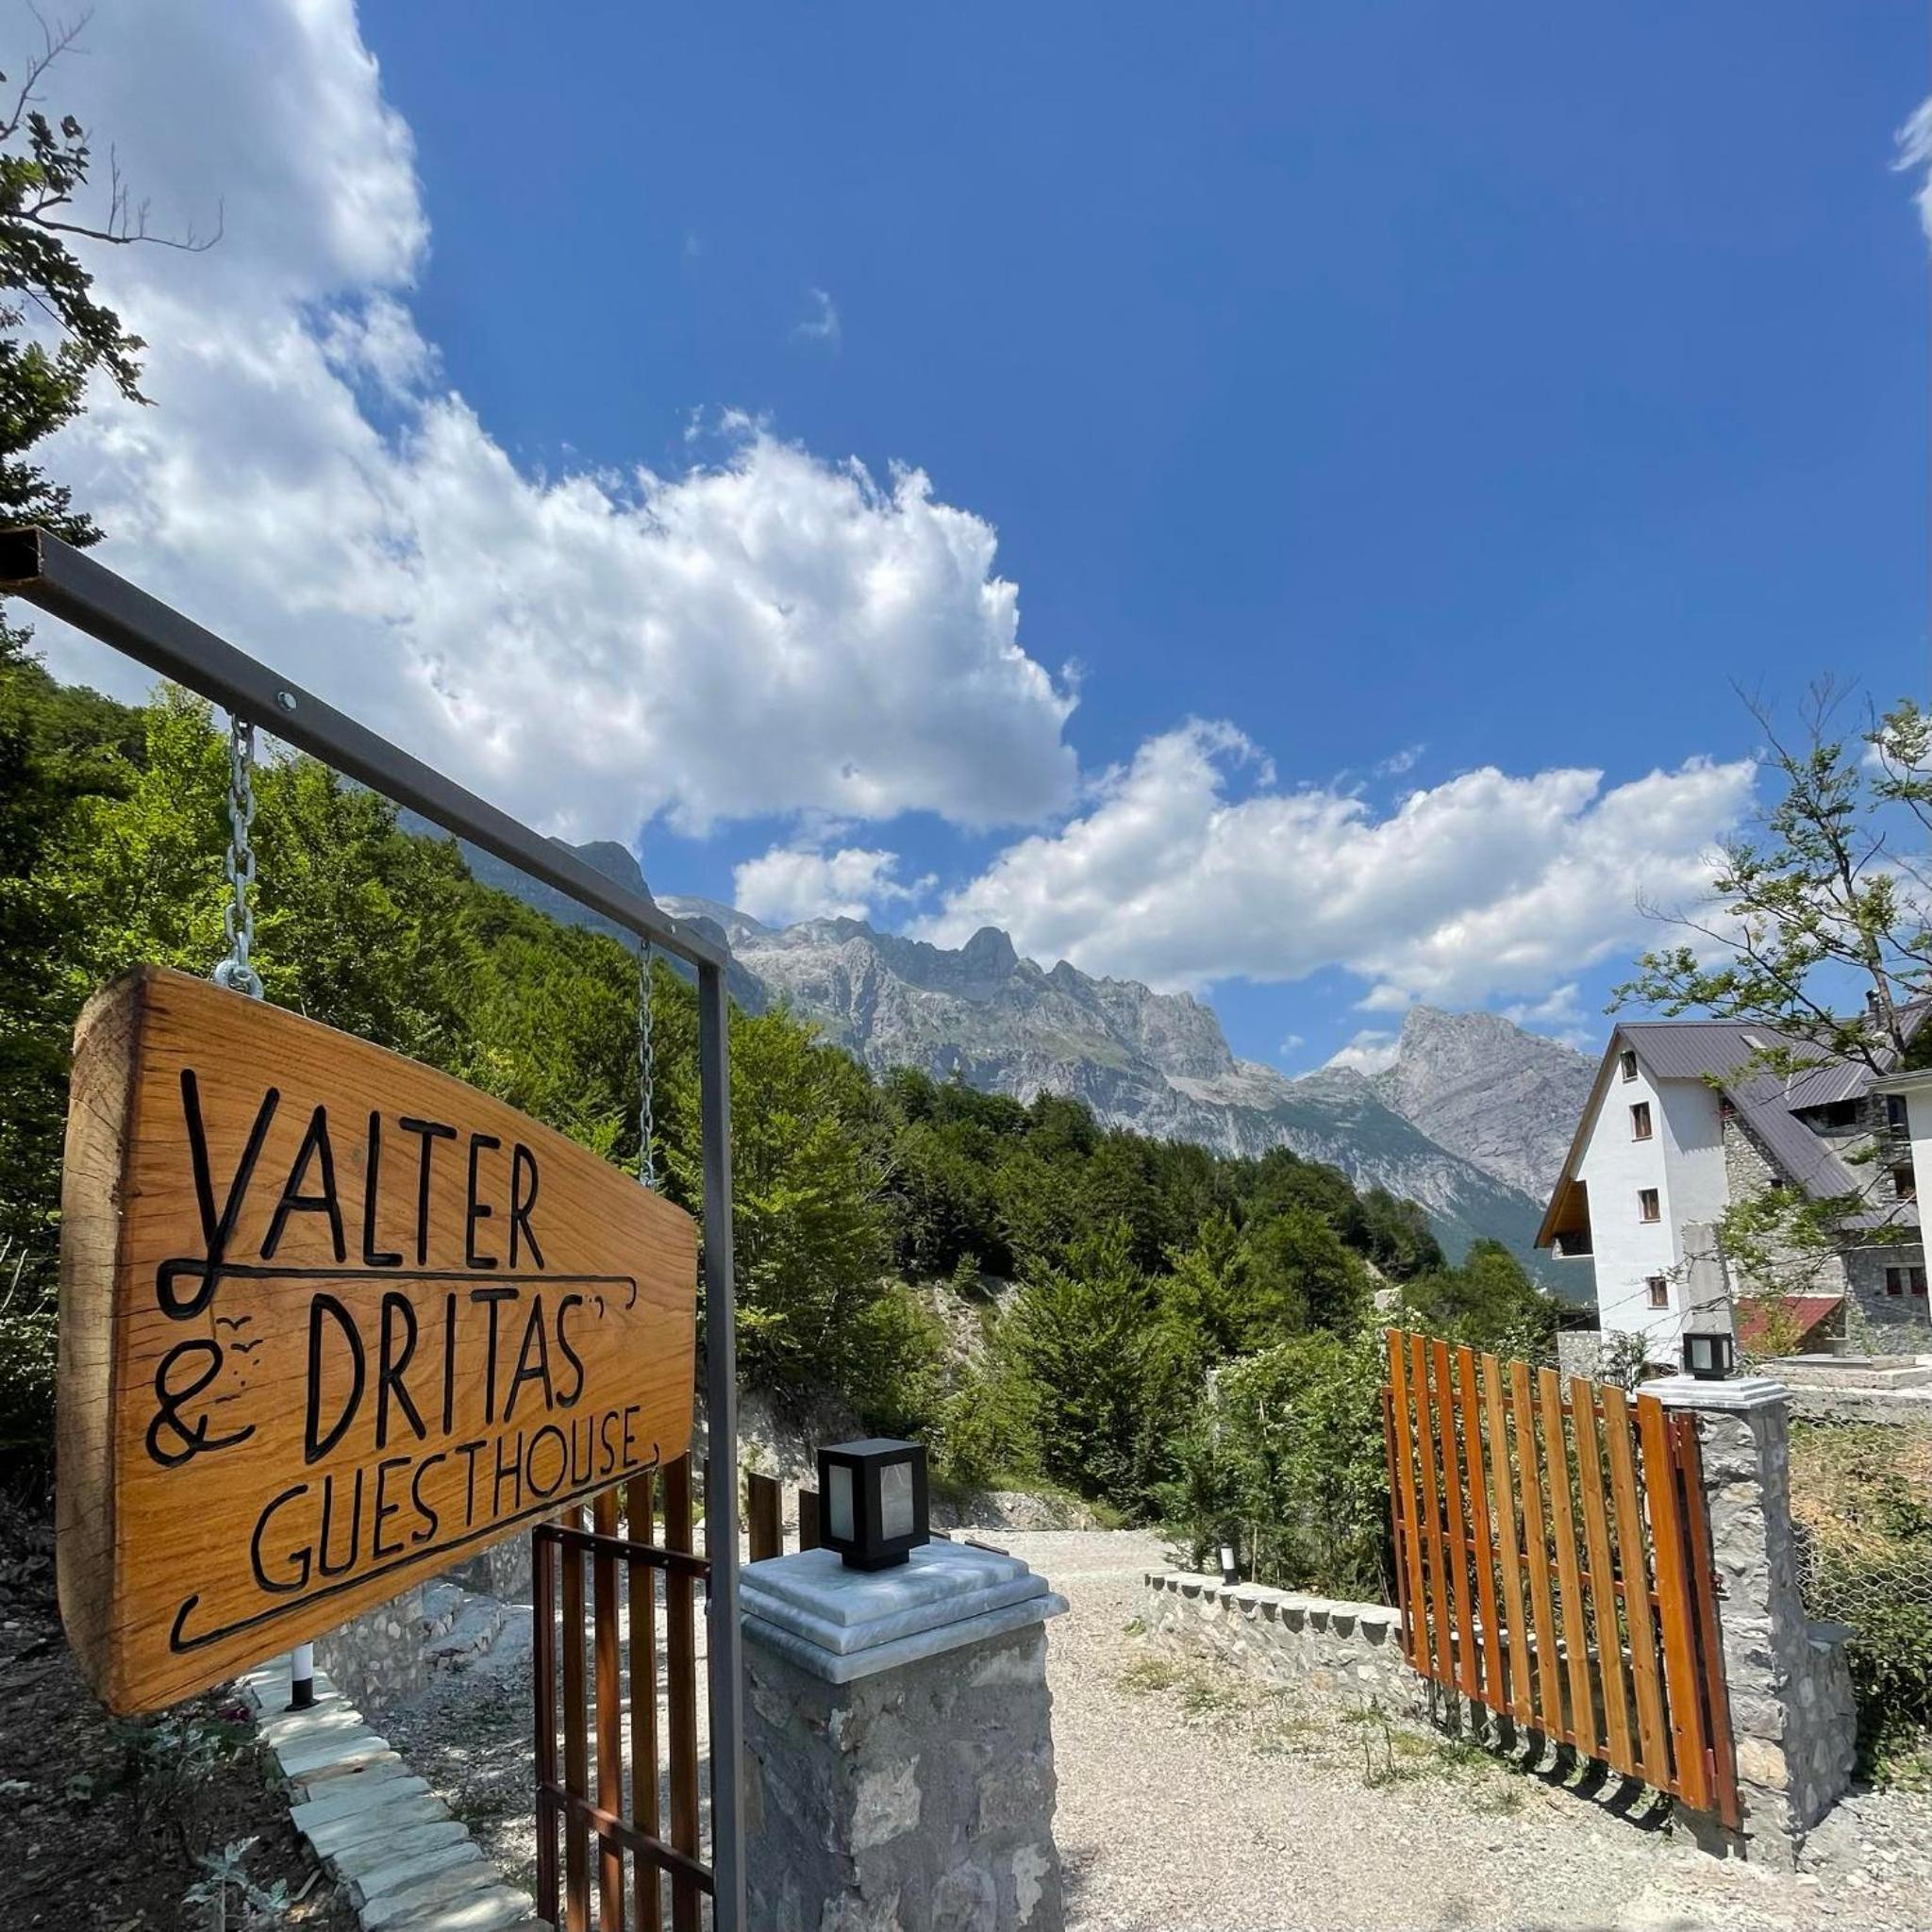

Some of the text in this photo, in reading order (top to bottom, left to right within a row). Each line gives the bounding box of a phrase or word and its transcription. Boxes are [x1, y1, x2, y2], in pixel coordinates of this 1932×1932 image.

[157, 1068, 545, 1321] VALTER
[145, 1338, 256, 1468] &
[250, 1405, 641, 1594] GUESTHOUSE
